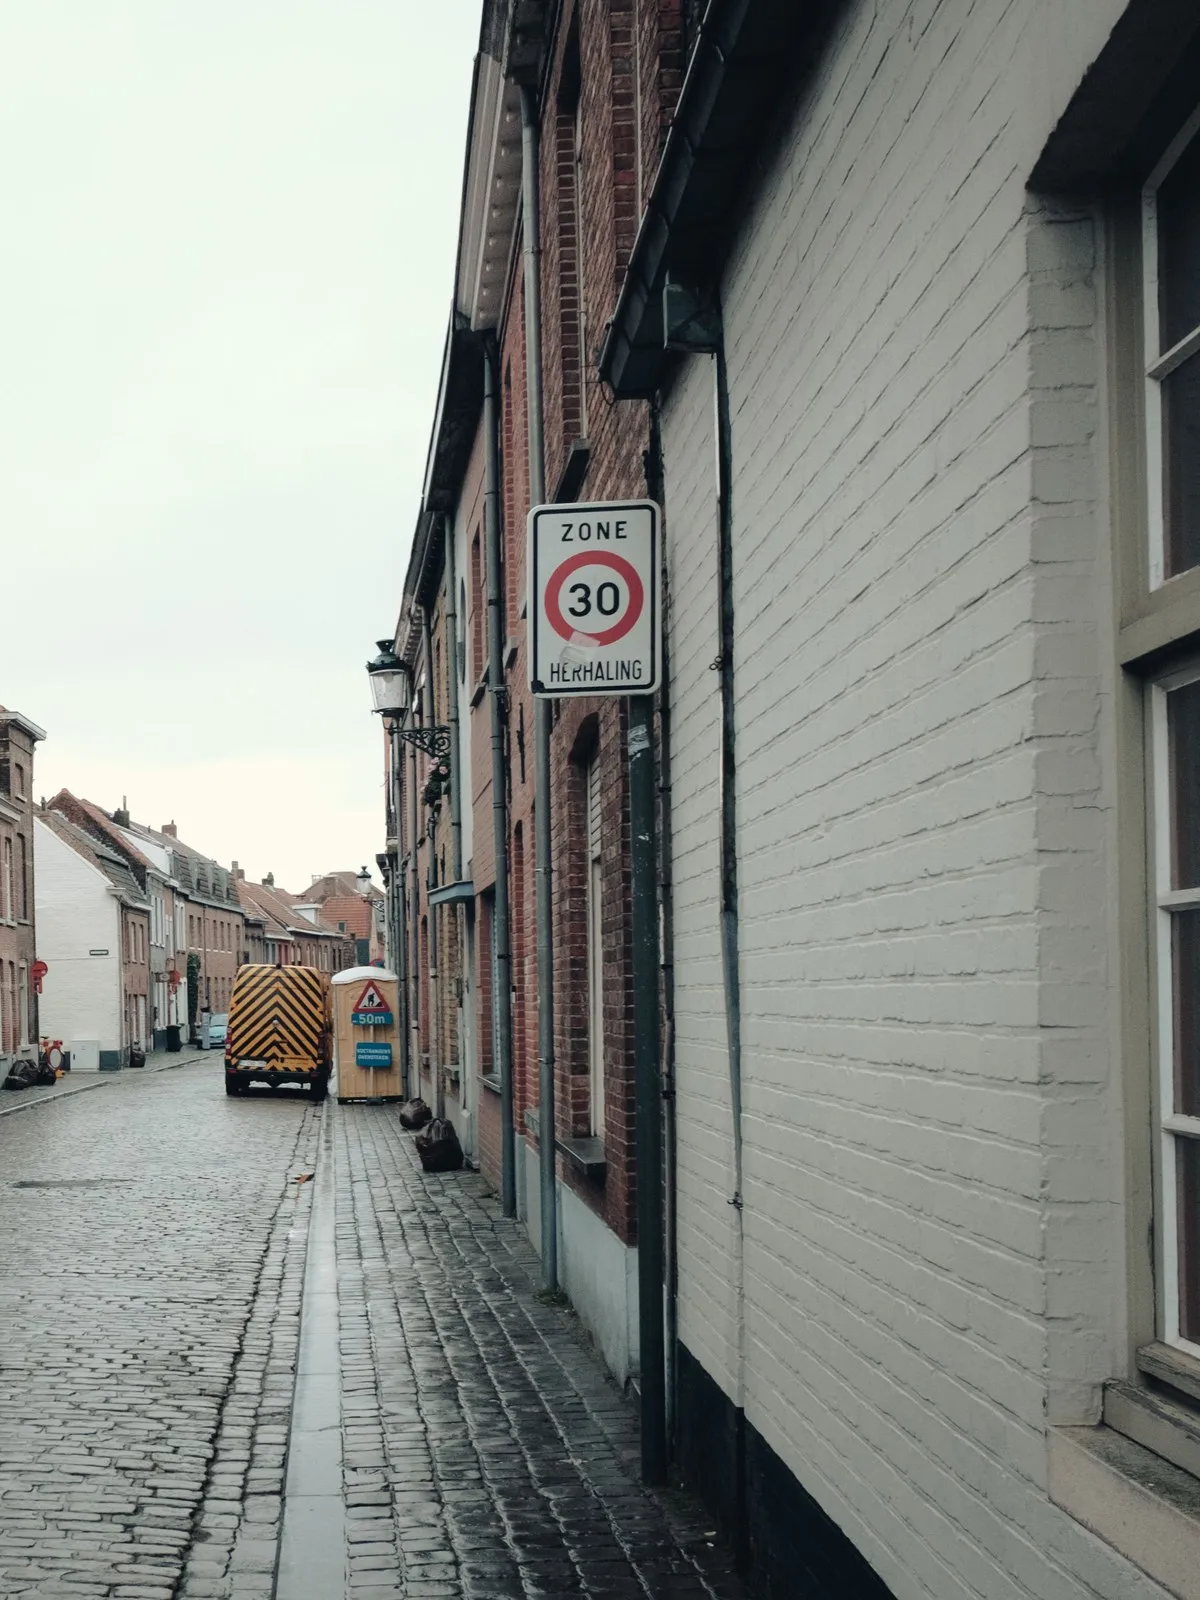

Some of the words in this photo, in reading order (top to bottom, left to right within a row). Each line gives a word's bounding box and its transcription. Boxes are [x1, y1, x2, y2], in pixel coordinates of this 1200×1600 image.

[561, 520, 628, 542] ZONE
[568, 581, 620, 618] 30
[550, 659, 642, 683] HERHALING
